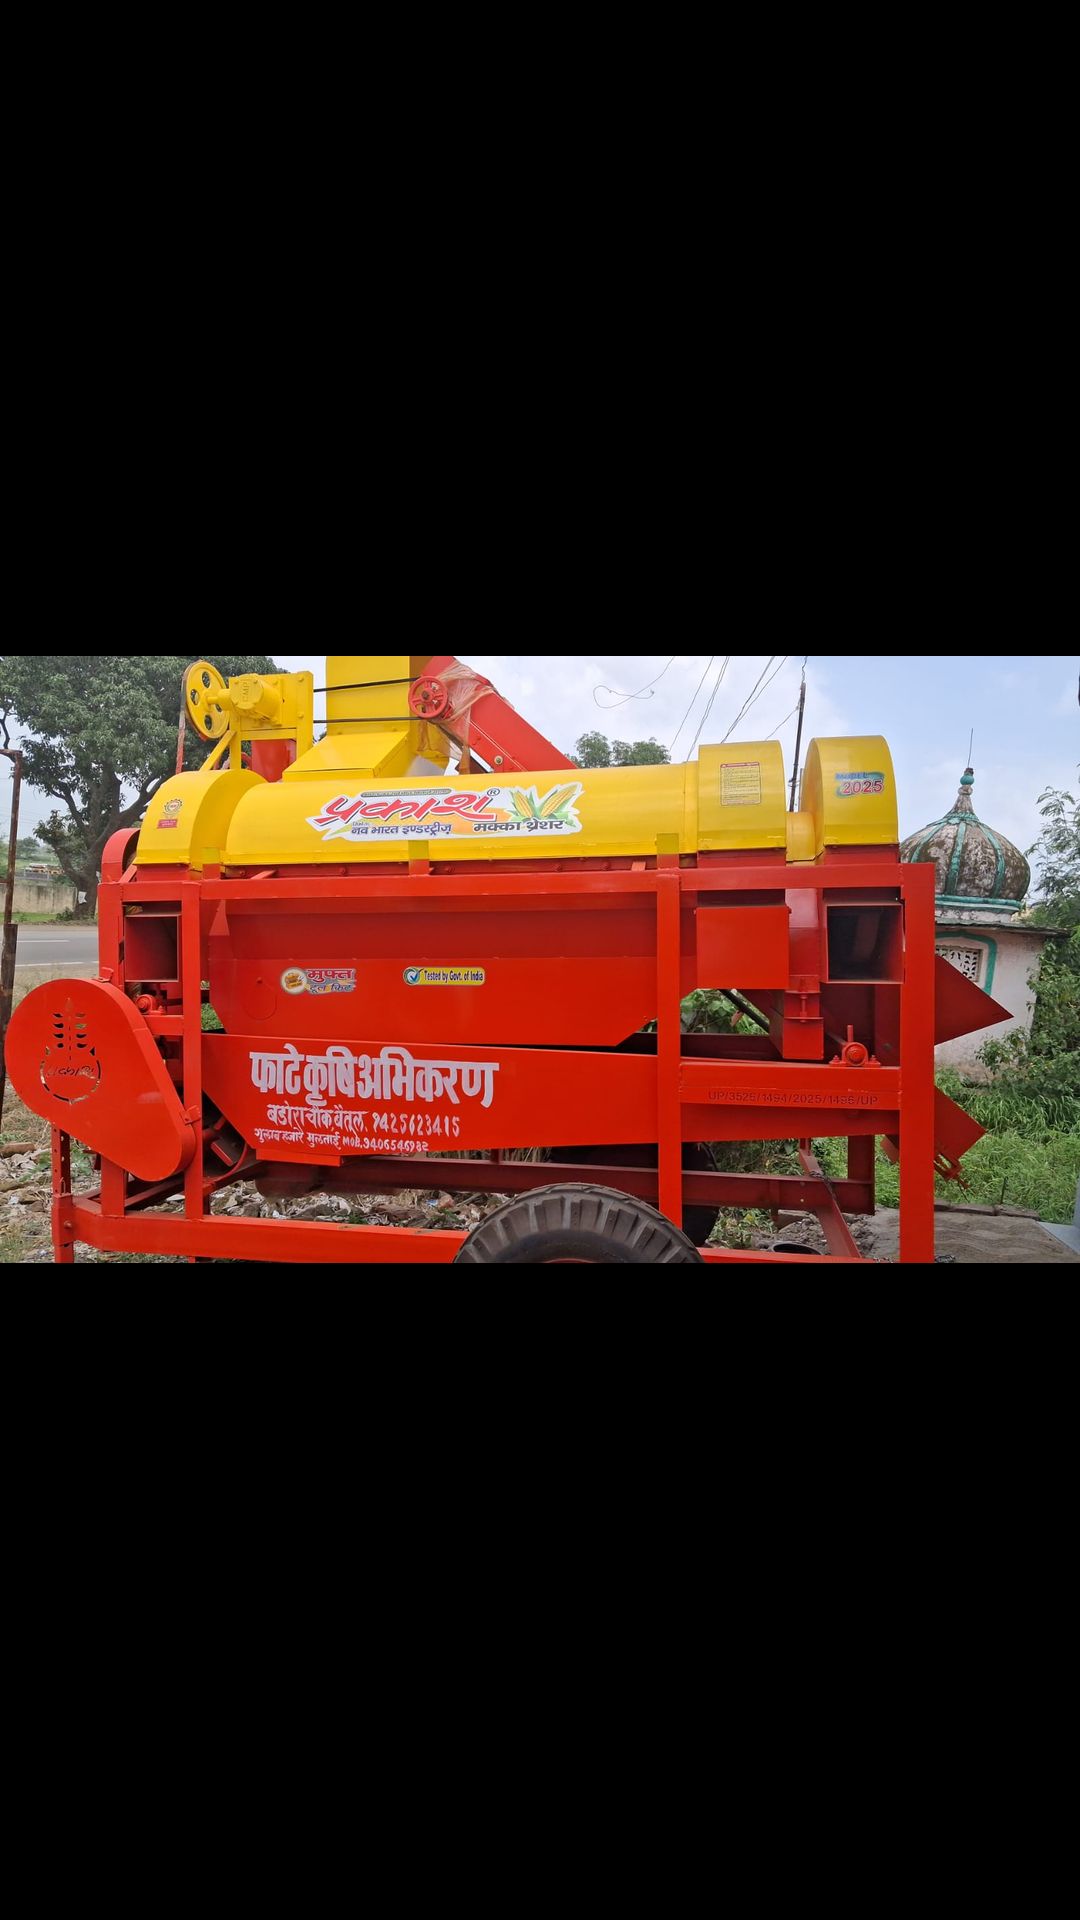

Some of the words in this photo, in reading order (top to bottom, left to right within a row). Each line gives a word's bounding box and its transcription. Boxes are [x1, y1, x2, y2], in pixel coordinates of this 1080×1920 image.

[841, 780, 884, 794] 2025
[312, 793, 496, 823] प्रकाश
[351, 825, 368, 835] नव
[371, 824, 398, 834] भारत
[473, 822, 521, 832] मक्का
[424, 970, 441, 981] Tested
[442, 970, 449, 983] by
[449, 970, 463, 981] Govt.
[464, 970, 470, 981] of
[471, 970, 483, 981] India
[249, 1043, 304, 1095] फाटे
[303, 1046, 357, 1106] कृषि
[356, 1046, 500, 1109] अभिकरण
[371, 1112, 460, 1137] 9425623415
